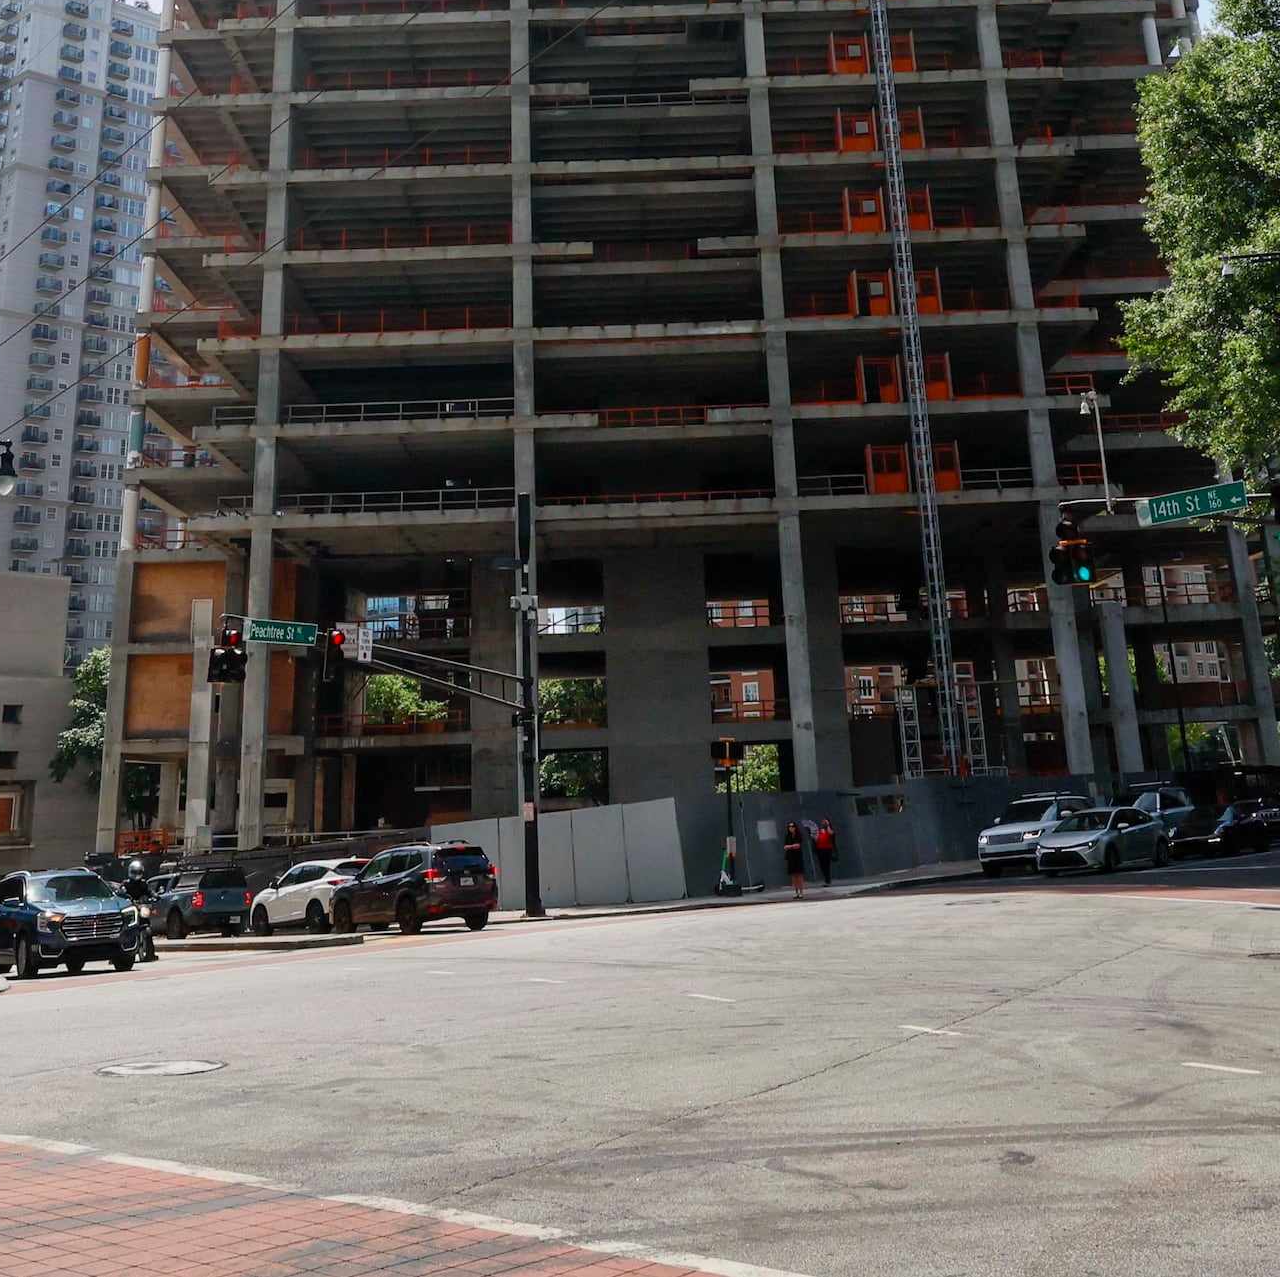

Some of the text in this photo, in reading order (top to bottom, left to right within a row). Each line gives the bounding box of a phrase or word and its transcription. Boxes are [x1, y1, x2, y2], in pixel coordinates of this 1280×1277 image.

[1153, 490, 1217, 518] 14th St NE
[1209, 499, 1222, 509] 160
[251, 623, 284, 640] Peachtree
[286, 626, 295, 640] St
